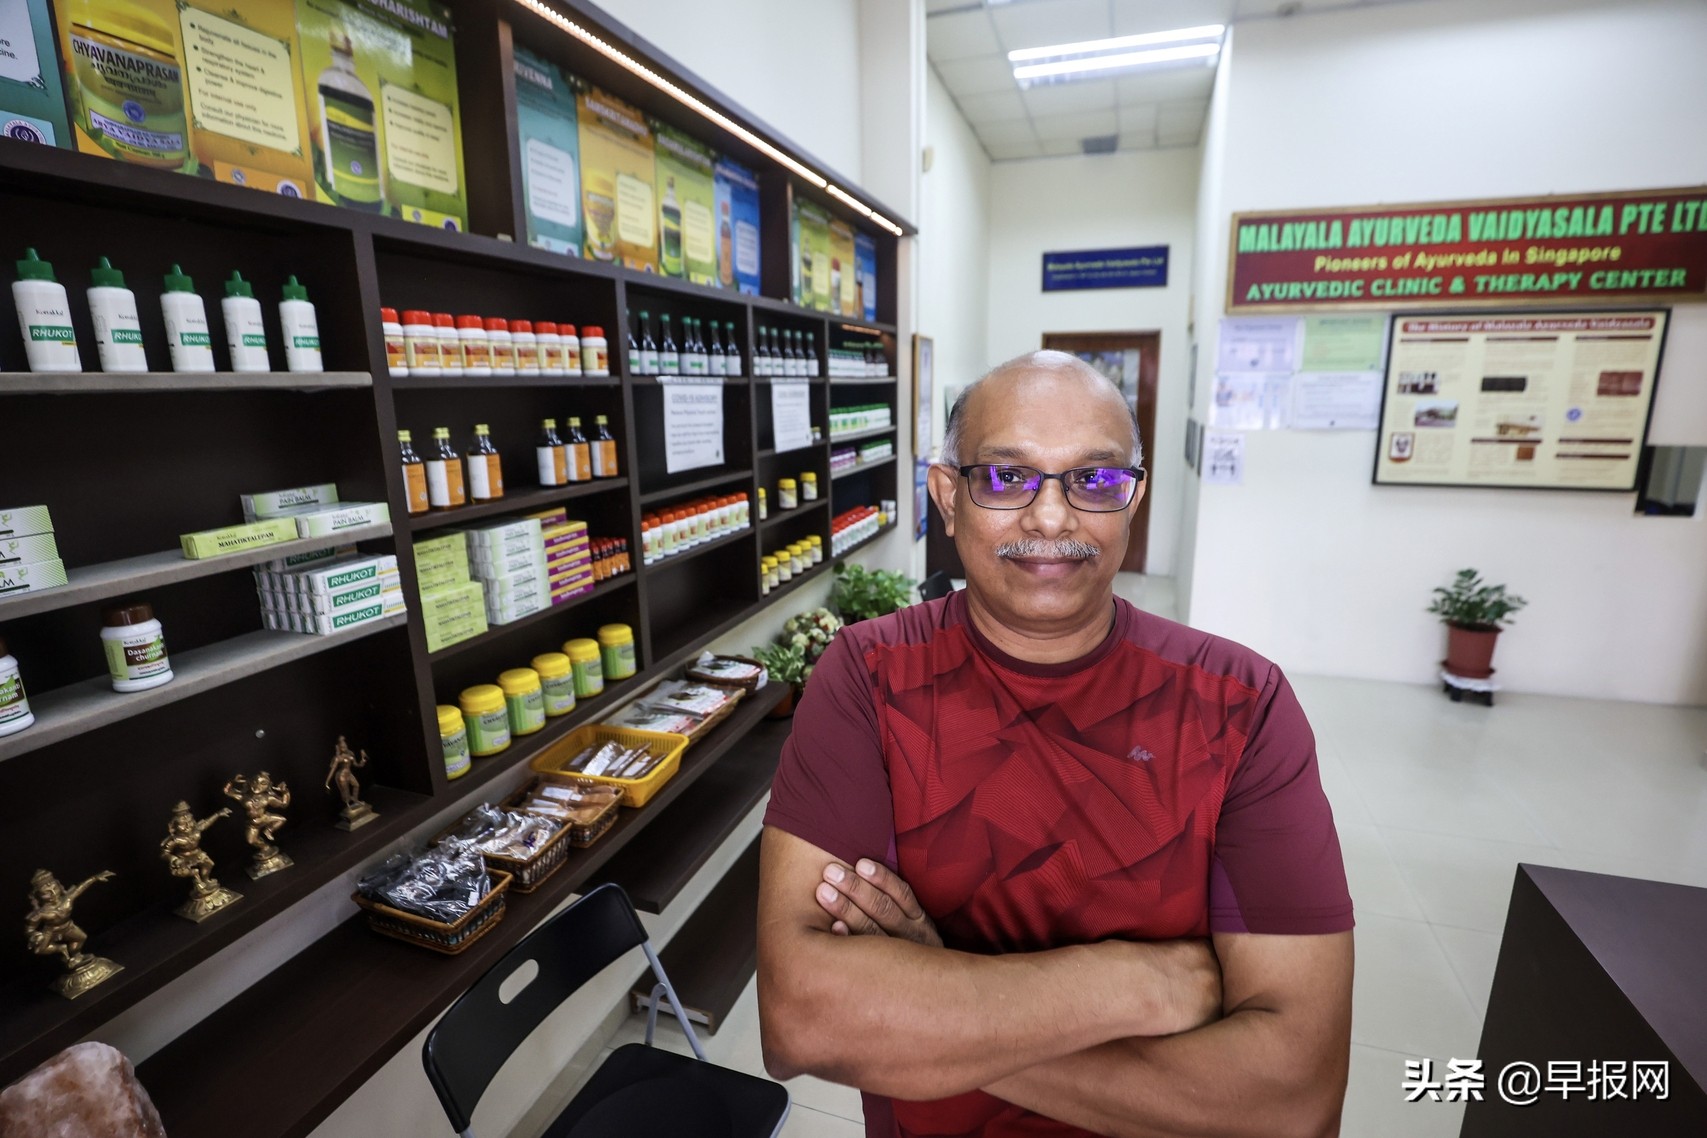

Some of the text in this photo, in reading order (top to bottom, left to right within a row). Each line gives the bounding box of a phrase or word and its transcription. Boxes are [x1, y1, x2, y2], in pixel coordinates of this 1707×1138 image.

[1238, 220, 1343, 253] MALAYALA
[1346, 214, 1462, 248] AYURVEDA
[1468, 204, 1614, 242] VAIDYASALA
[1619, 202, 1668, 235] PTE
[1314, 255, 1388, 272] Pioneers
[1392, 252, 1412, 269] of
[1414, 248, 1497, 271] Ayurveda
[1525, 245, 1621, 267] Singapore
[1246, 269, 1687, 300] AYURVEDIC CLINIC & THERAPY CENTER
[32, 328, 72, 338] RHUKOT
[331, 567, 374, 586] RHUKOT
[336, 586, 378, 604] RHUKOT
[336, 606, 380, 625] RHUKOT
